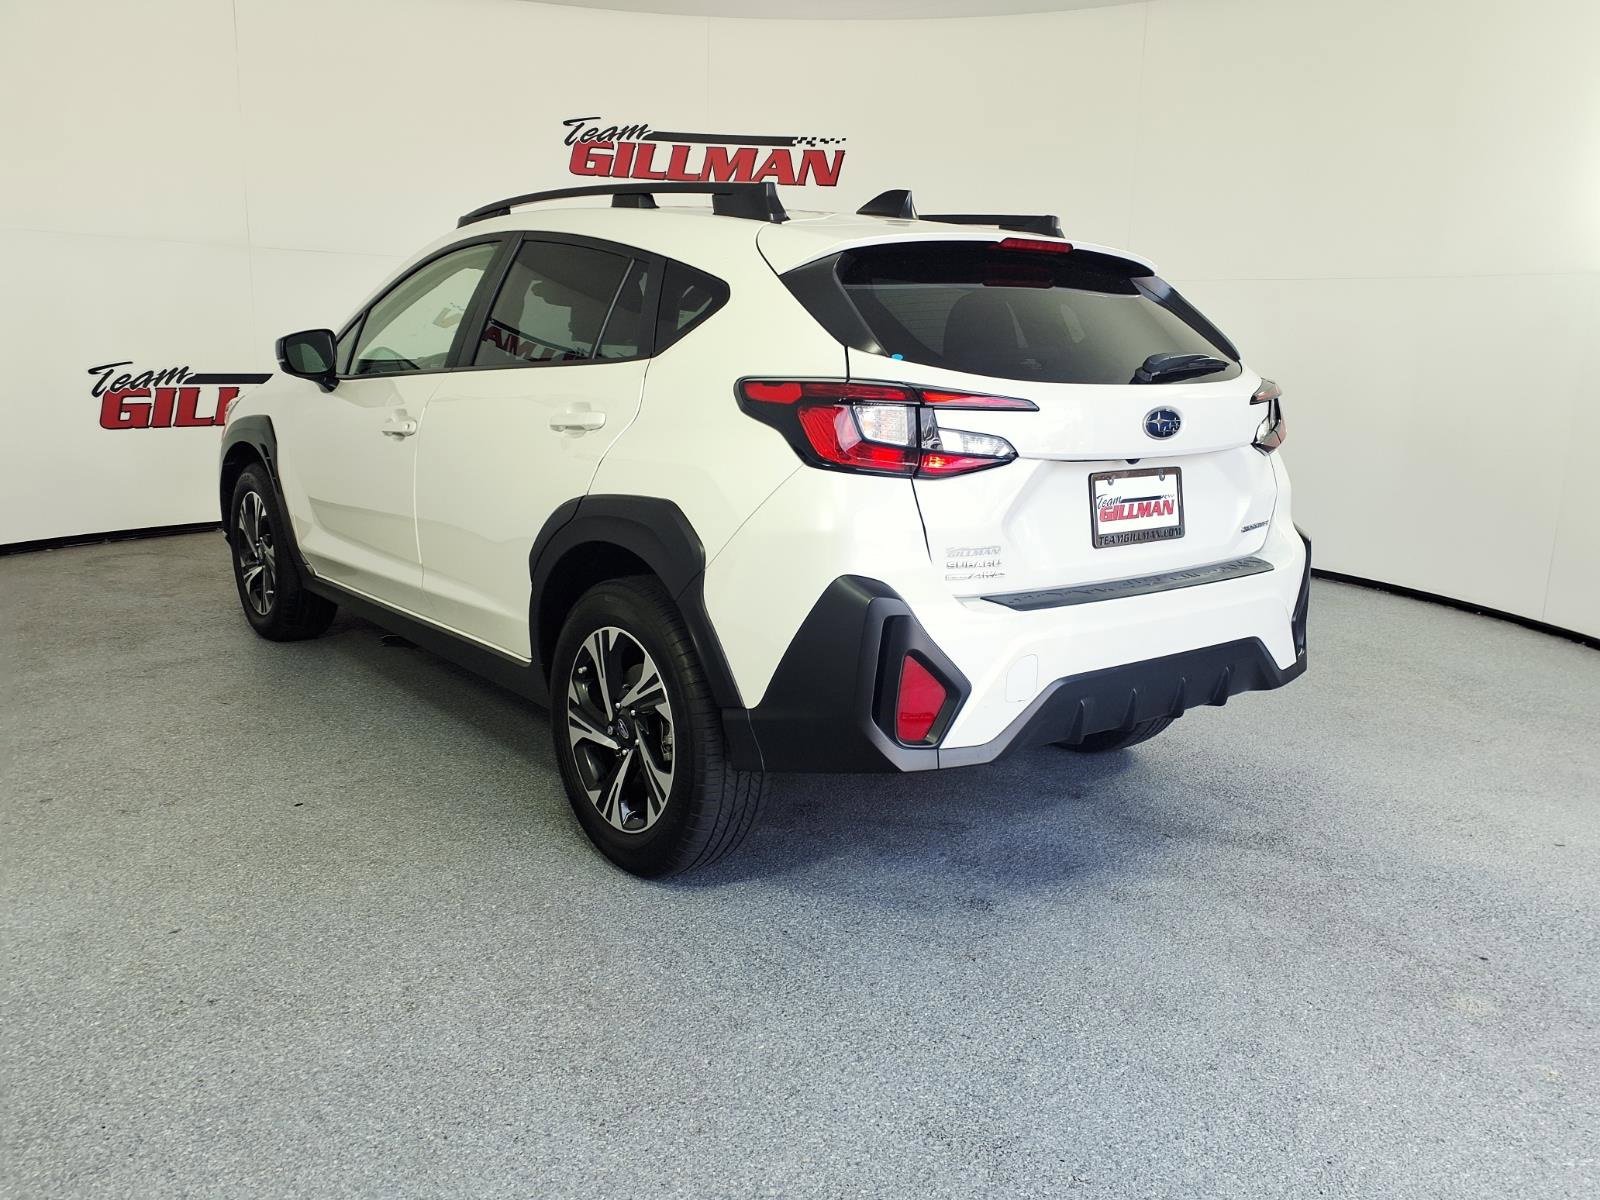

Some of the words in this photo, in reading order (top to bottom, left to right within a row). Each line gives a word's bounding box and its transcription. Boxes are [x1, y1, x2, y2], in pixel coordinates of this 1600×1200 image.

[562, 116, 651, 146] Team
[569, 140, 846, 187] GILLMAN
[88, 361, 194, 398] Team
[1096, 494, 1122, 510] Team
[1099, 499, 1175, 522] GILLMAN
